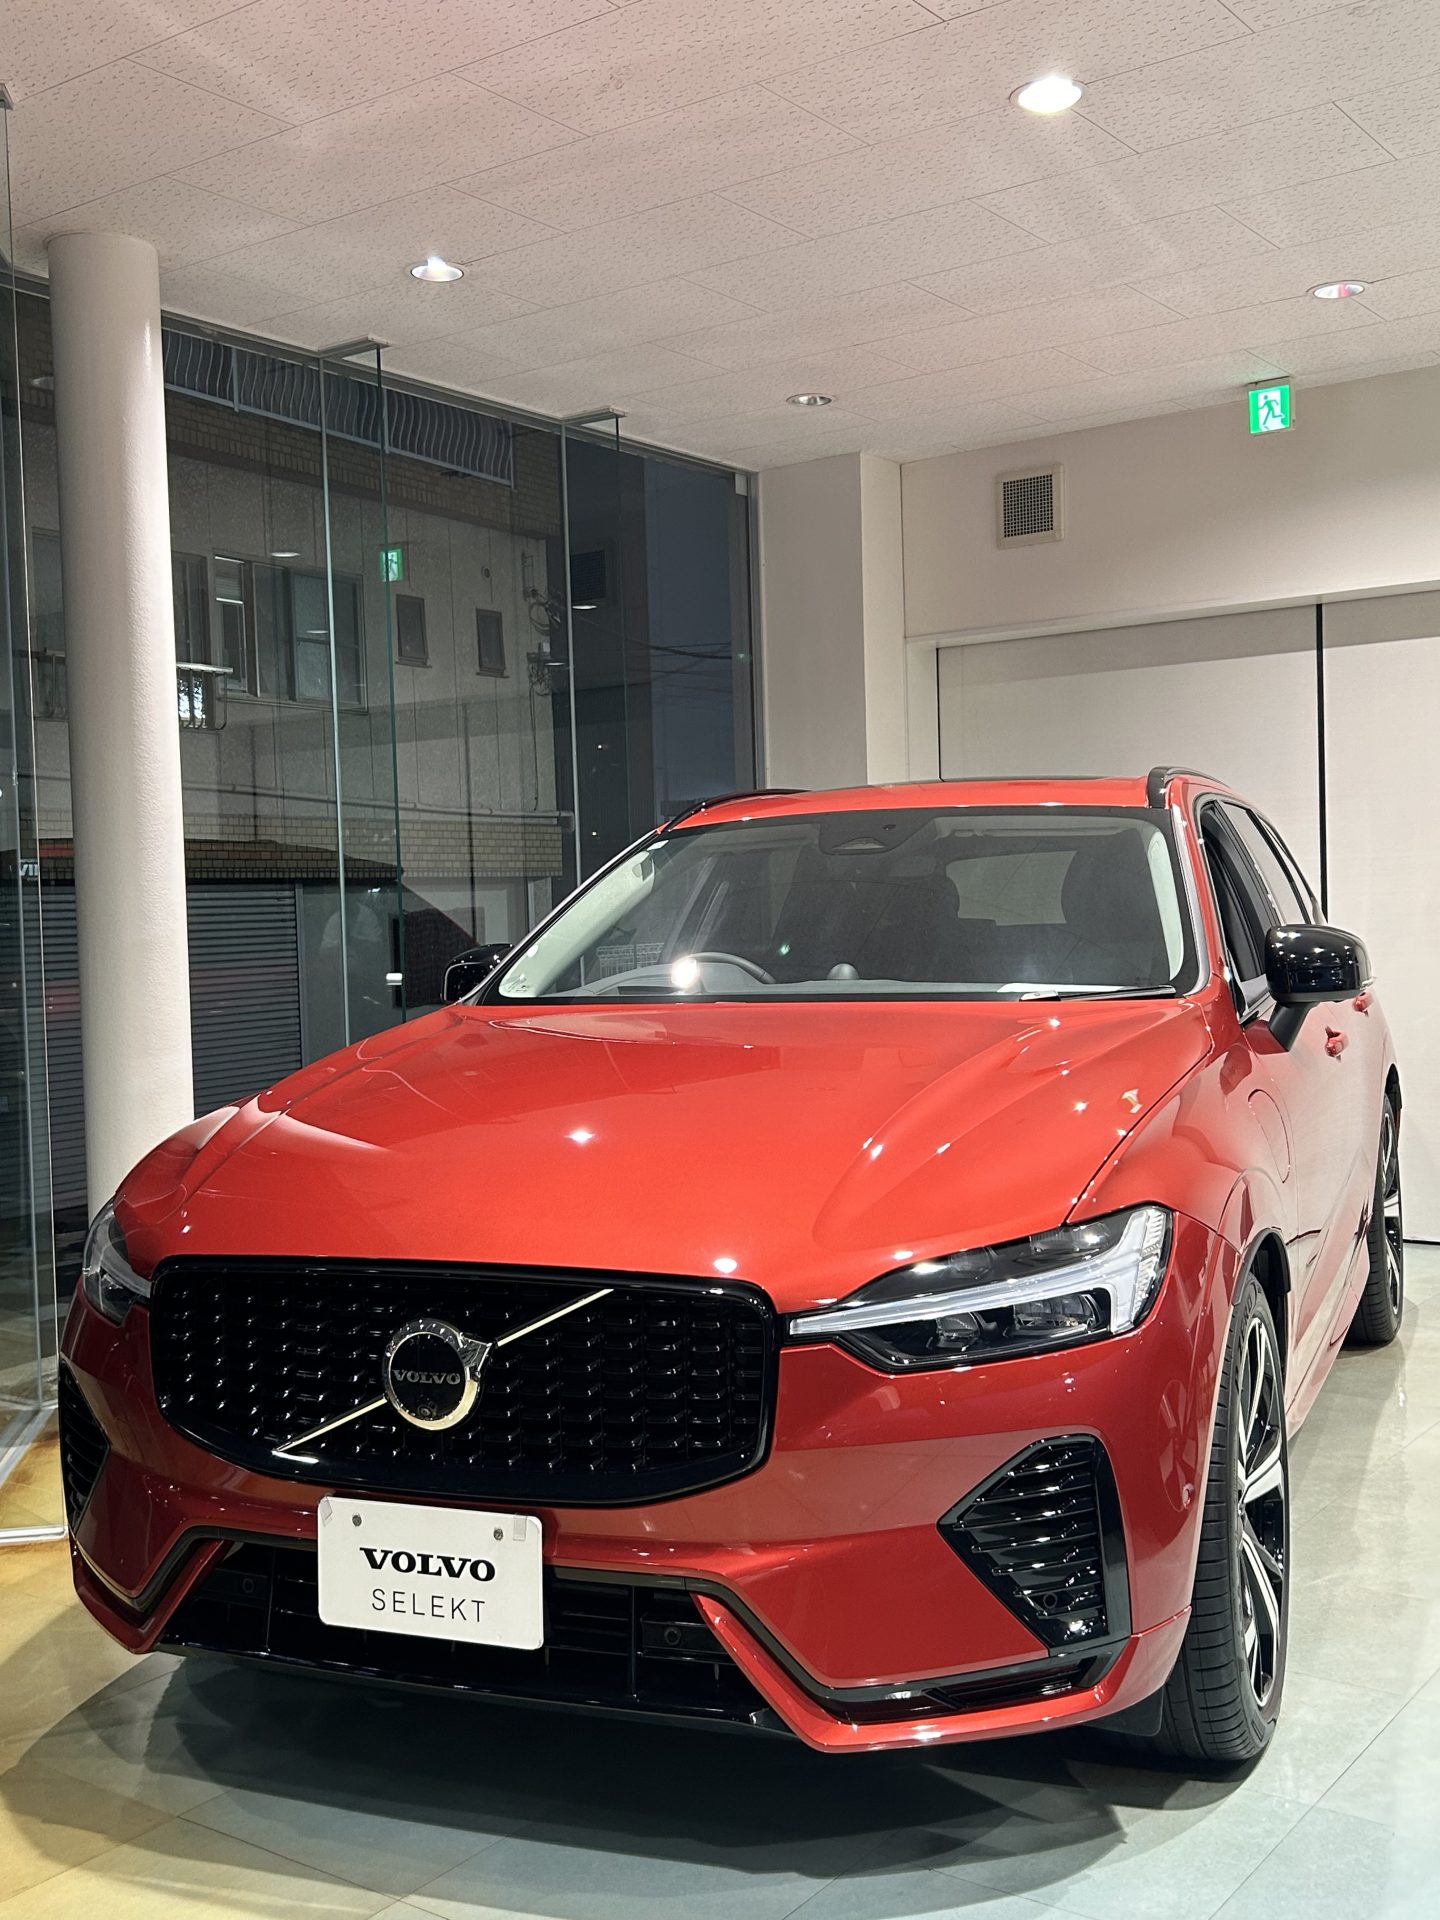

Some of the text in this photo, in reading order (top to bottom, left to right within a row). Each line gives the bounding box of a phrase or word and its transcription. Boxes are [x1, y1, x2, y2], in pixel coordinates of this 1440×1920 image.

[392, 1369, 461, 1385] VOLVO
[360, 1547, 496, 1582] VOLVO
[372, 1588, 486, 1623] SELEKT
